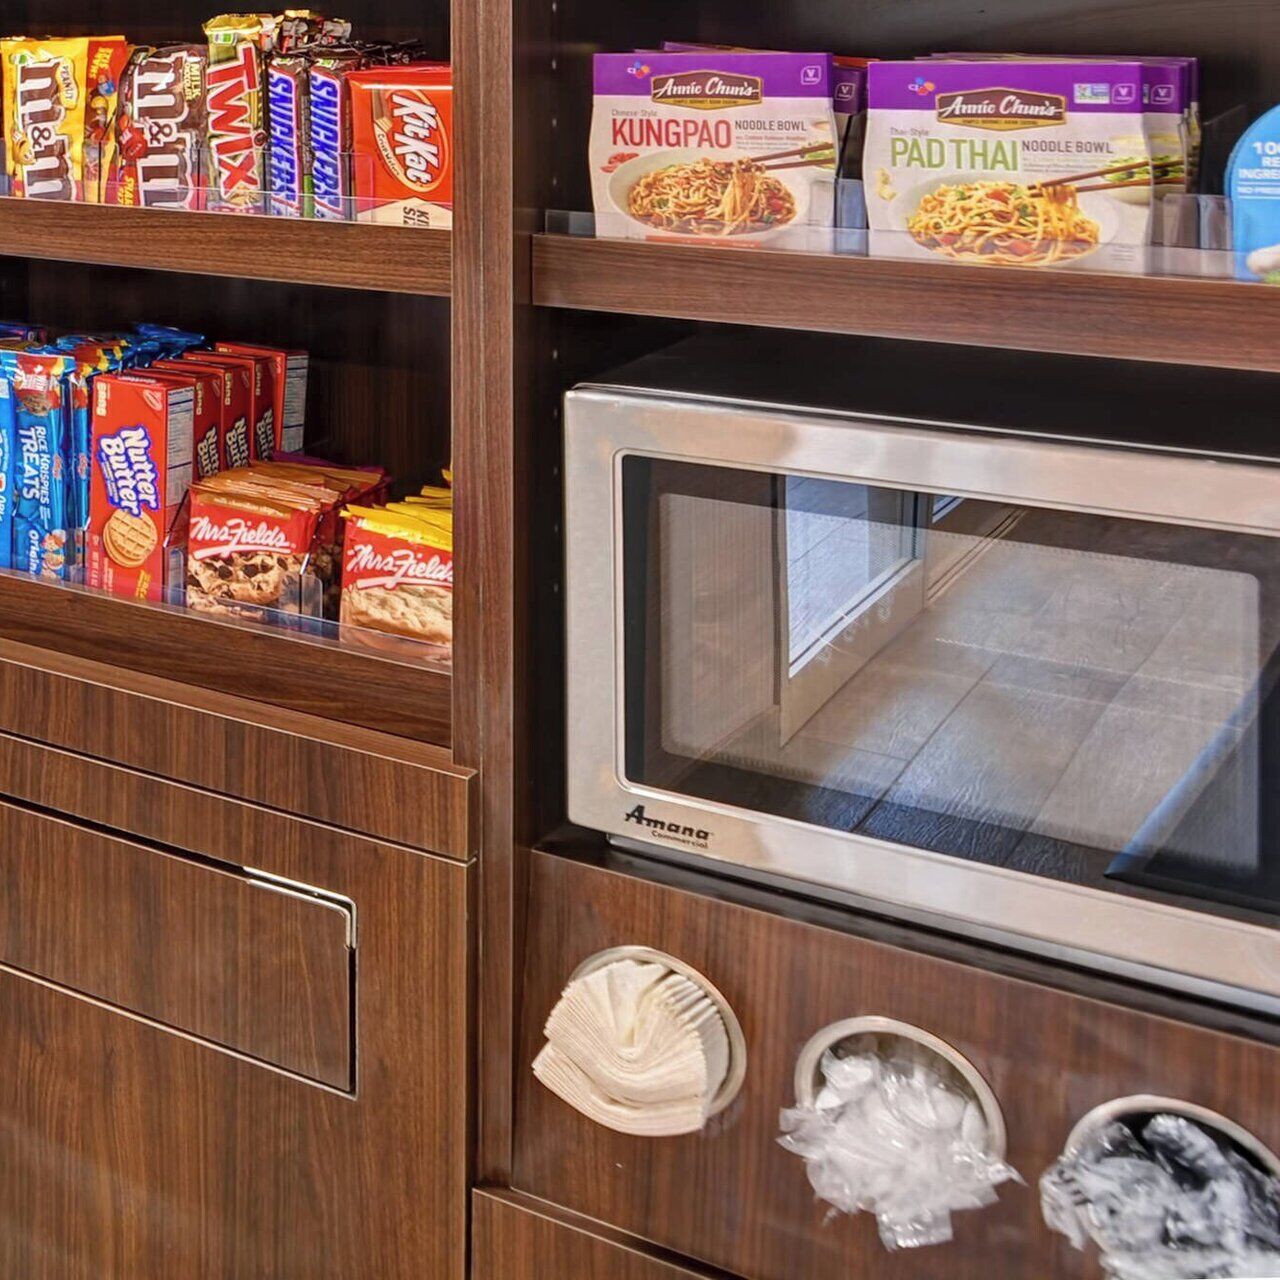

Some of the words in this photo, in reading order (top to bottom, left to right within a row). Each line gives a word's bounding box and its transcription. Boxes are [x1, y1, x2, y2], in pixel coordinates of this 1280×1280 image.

[60, 64, 75, 101] PEANUT
[190, 62, 202, 102] MILK
[652, 78, 703, 98] Annie
[705, 77, 760, 97] Chun's
[208, 44, 259, 199] TWIX
[938, 97, 996, 117] Annie
[1000, 96, 1063, 116] Chun's
[268, 69, 298, 205] SNICKERS
[310, 70, 341, 216] SNICKERS
[734, 120, 776, 132] NOODLE
[777, 120, 808, 132] BOWL
[890, 137, 946, 169] PAD
[949, 138, 1018, 171] THAI
[1022, 140, 1072, 153] NOODLE
[1075, 141, 1114, 154] BOWL
[37, 425, 47, 451] RICE
[20, 426, 40, 500] TREATS
[39, 451, 50, 507] KRISPIES
[101, 436, 141, 516] Butter
[122, 425, 158, 510] Nutter
[624, 804, 710, 840] Amana
[651, 830, 709, 849] Commercial
